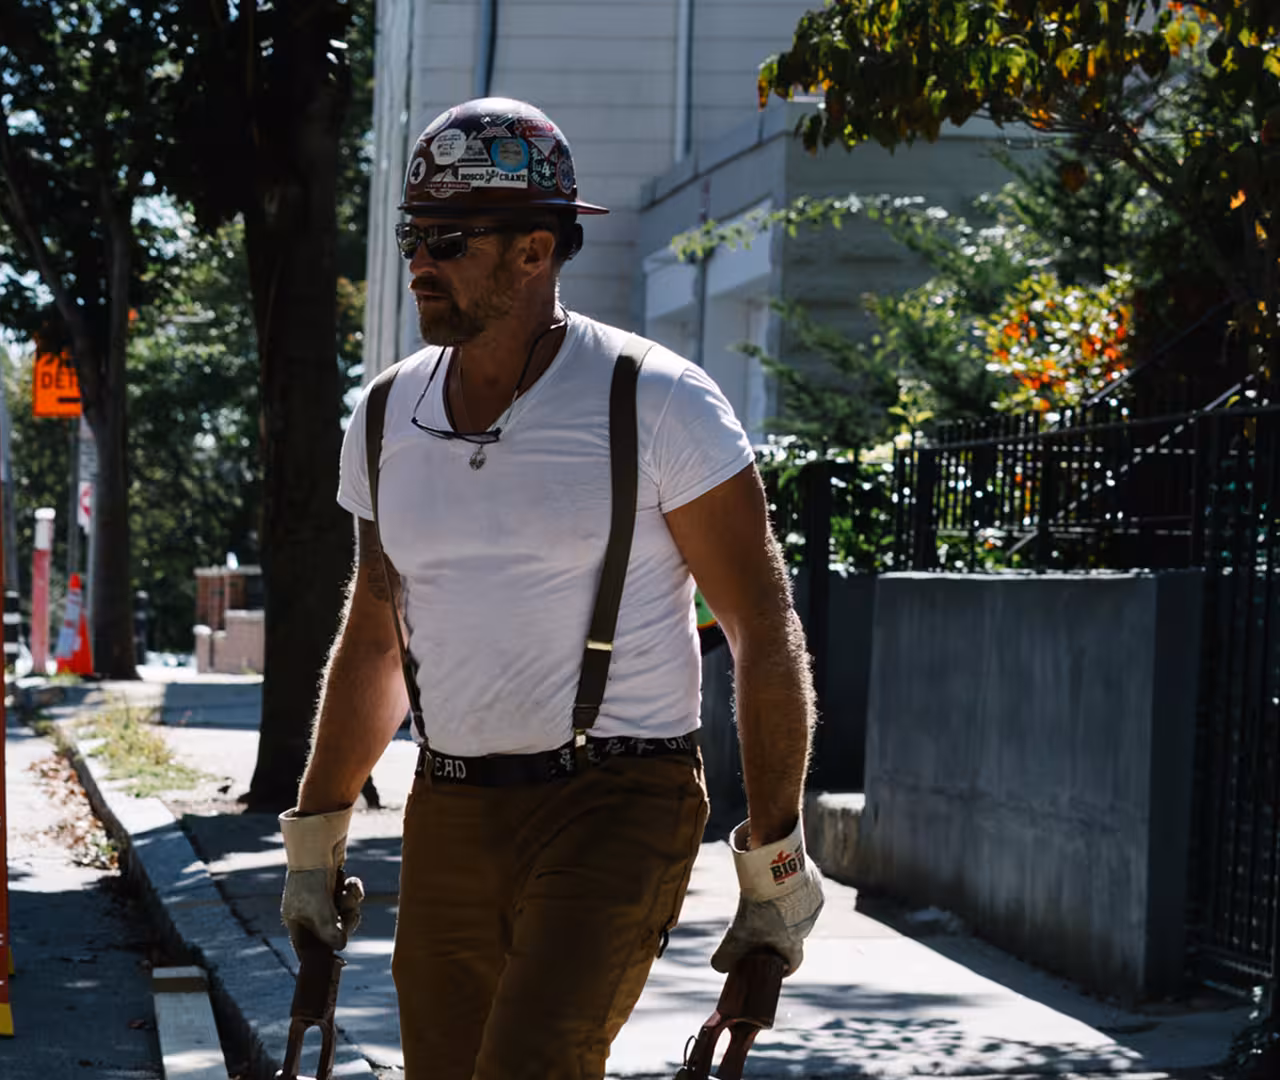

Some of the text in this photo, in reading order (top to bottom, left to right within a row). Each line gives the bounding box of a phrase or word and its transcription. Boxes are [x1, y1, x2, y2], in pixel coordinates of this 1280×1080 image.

[411, 160, 421, 181] 4
[434, 756, 467, 779] EAD
[770, 859, 797, 880] BIG
